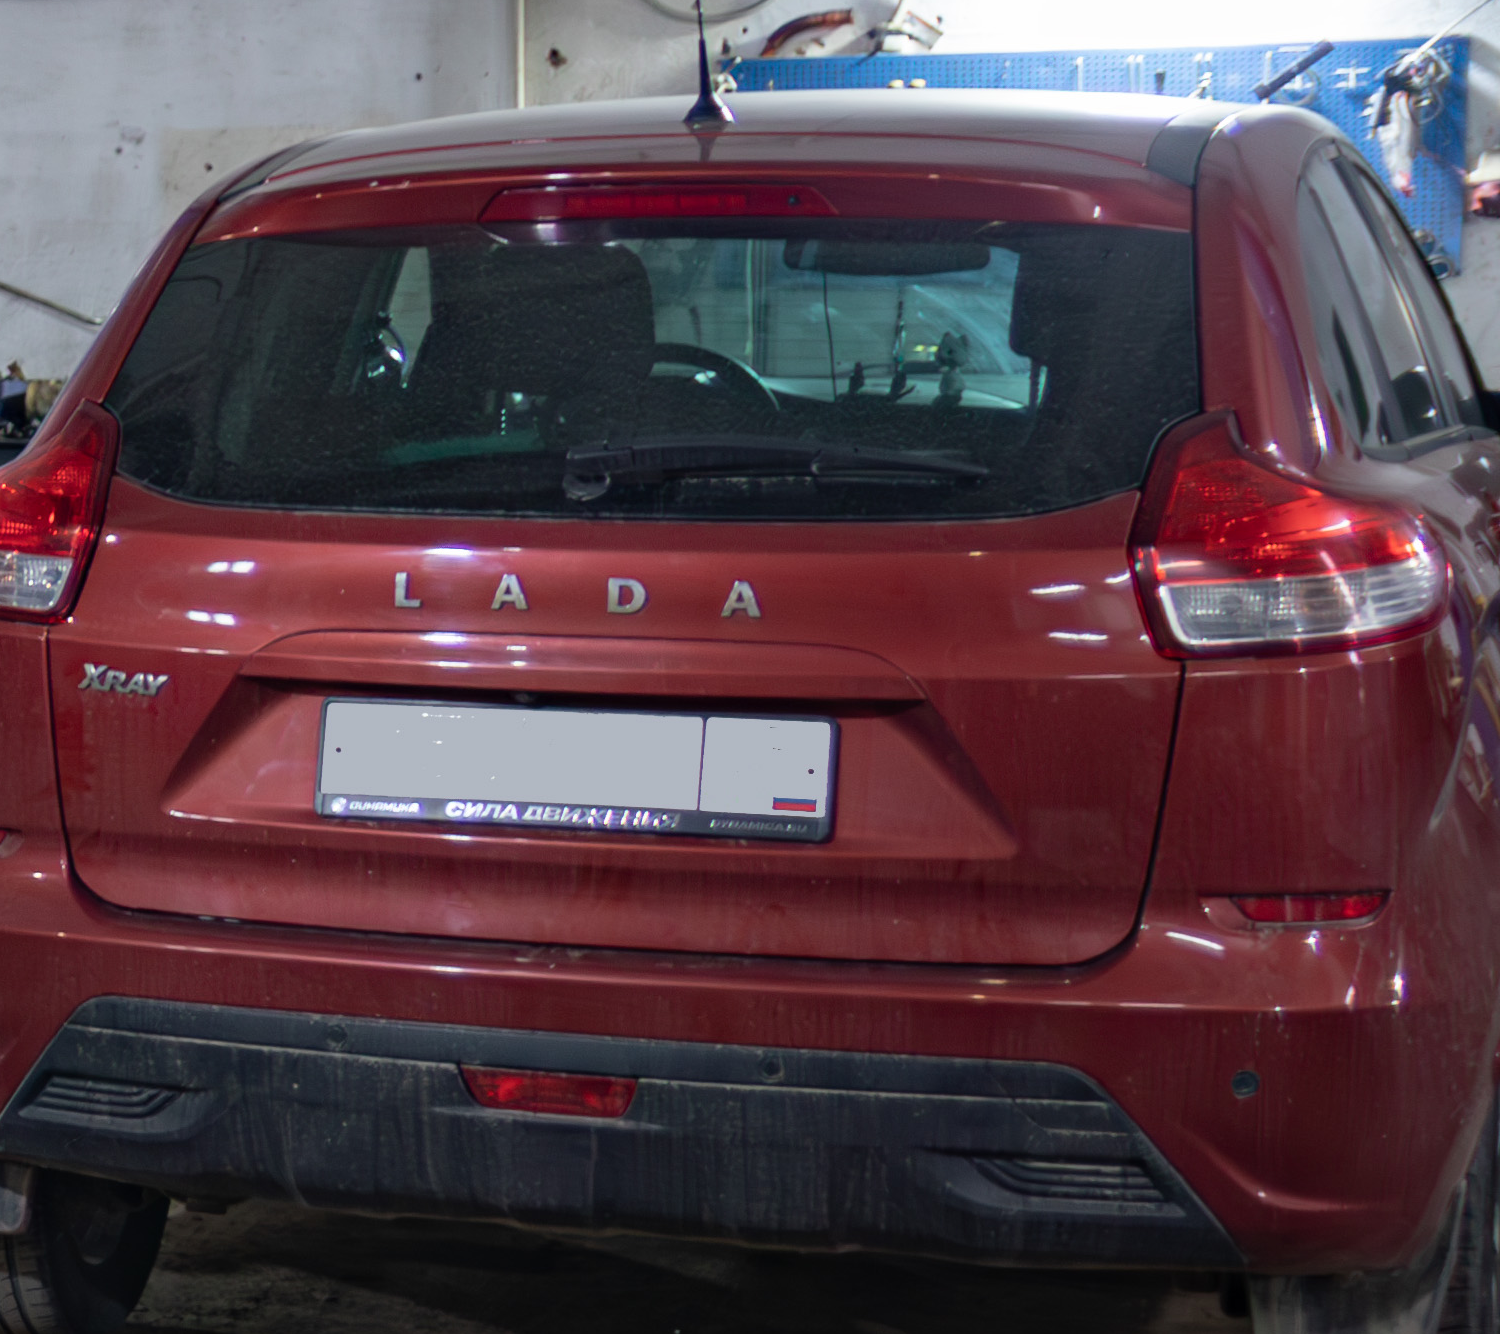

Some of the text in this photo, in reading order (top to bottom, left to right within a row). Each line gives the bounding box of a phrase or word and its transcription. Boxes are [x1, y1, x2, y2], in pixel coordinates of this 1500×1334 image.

[395, 572, 761, 617] LADA
[78, 663, 169, 696] XRAY
[445, 801, 681, 830] СИЛА ДВИЖЕНИЯ
